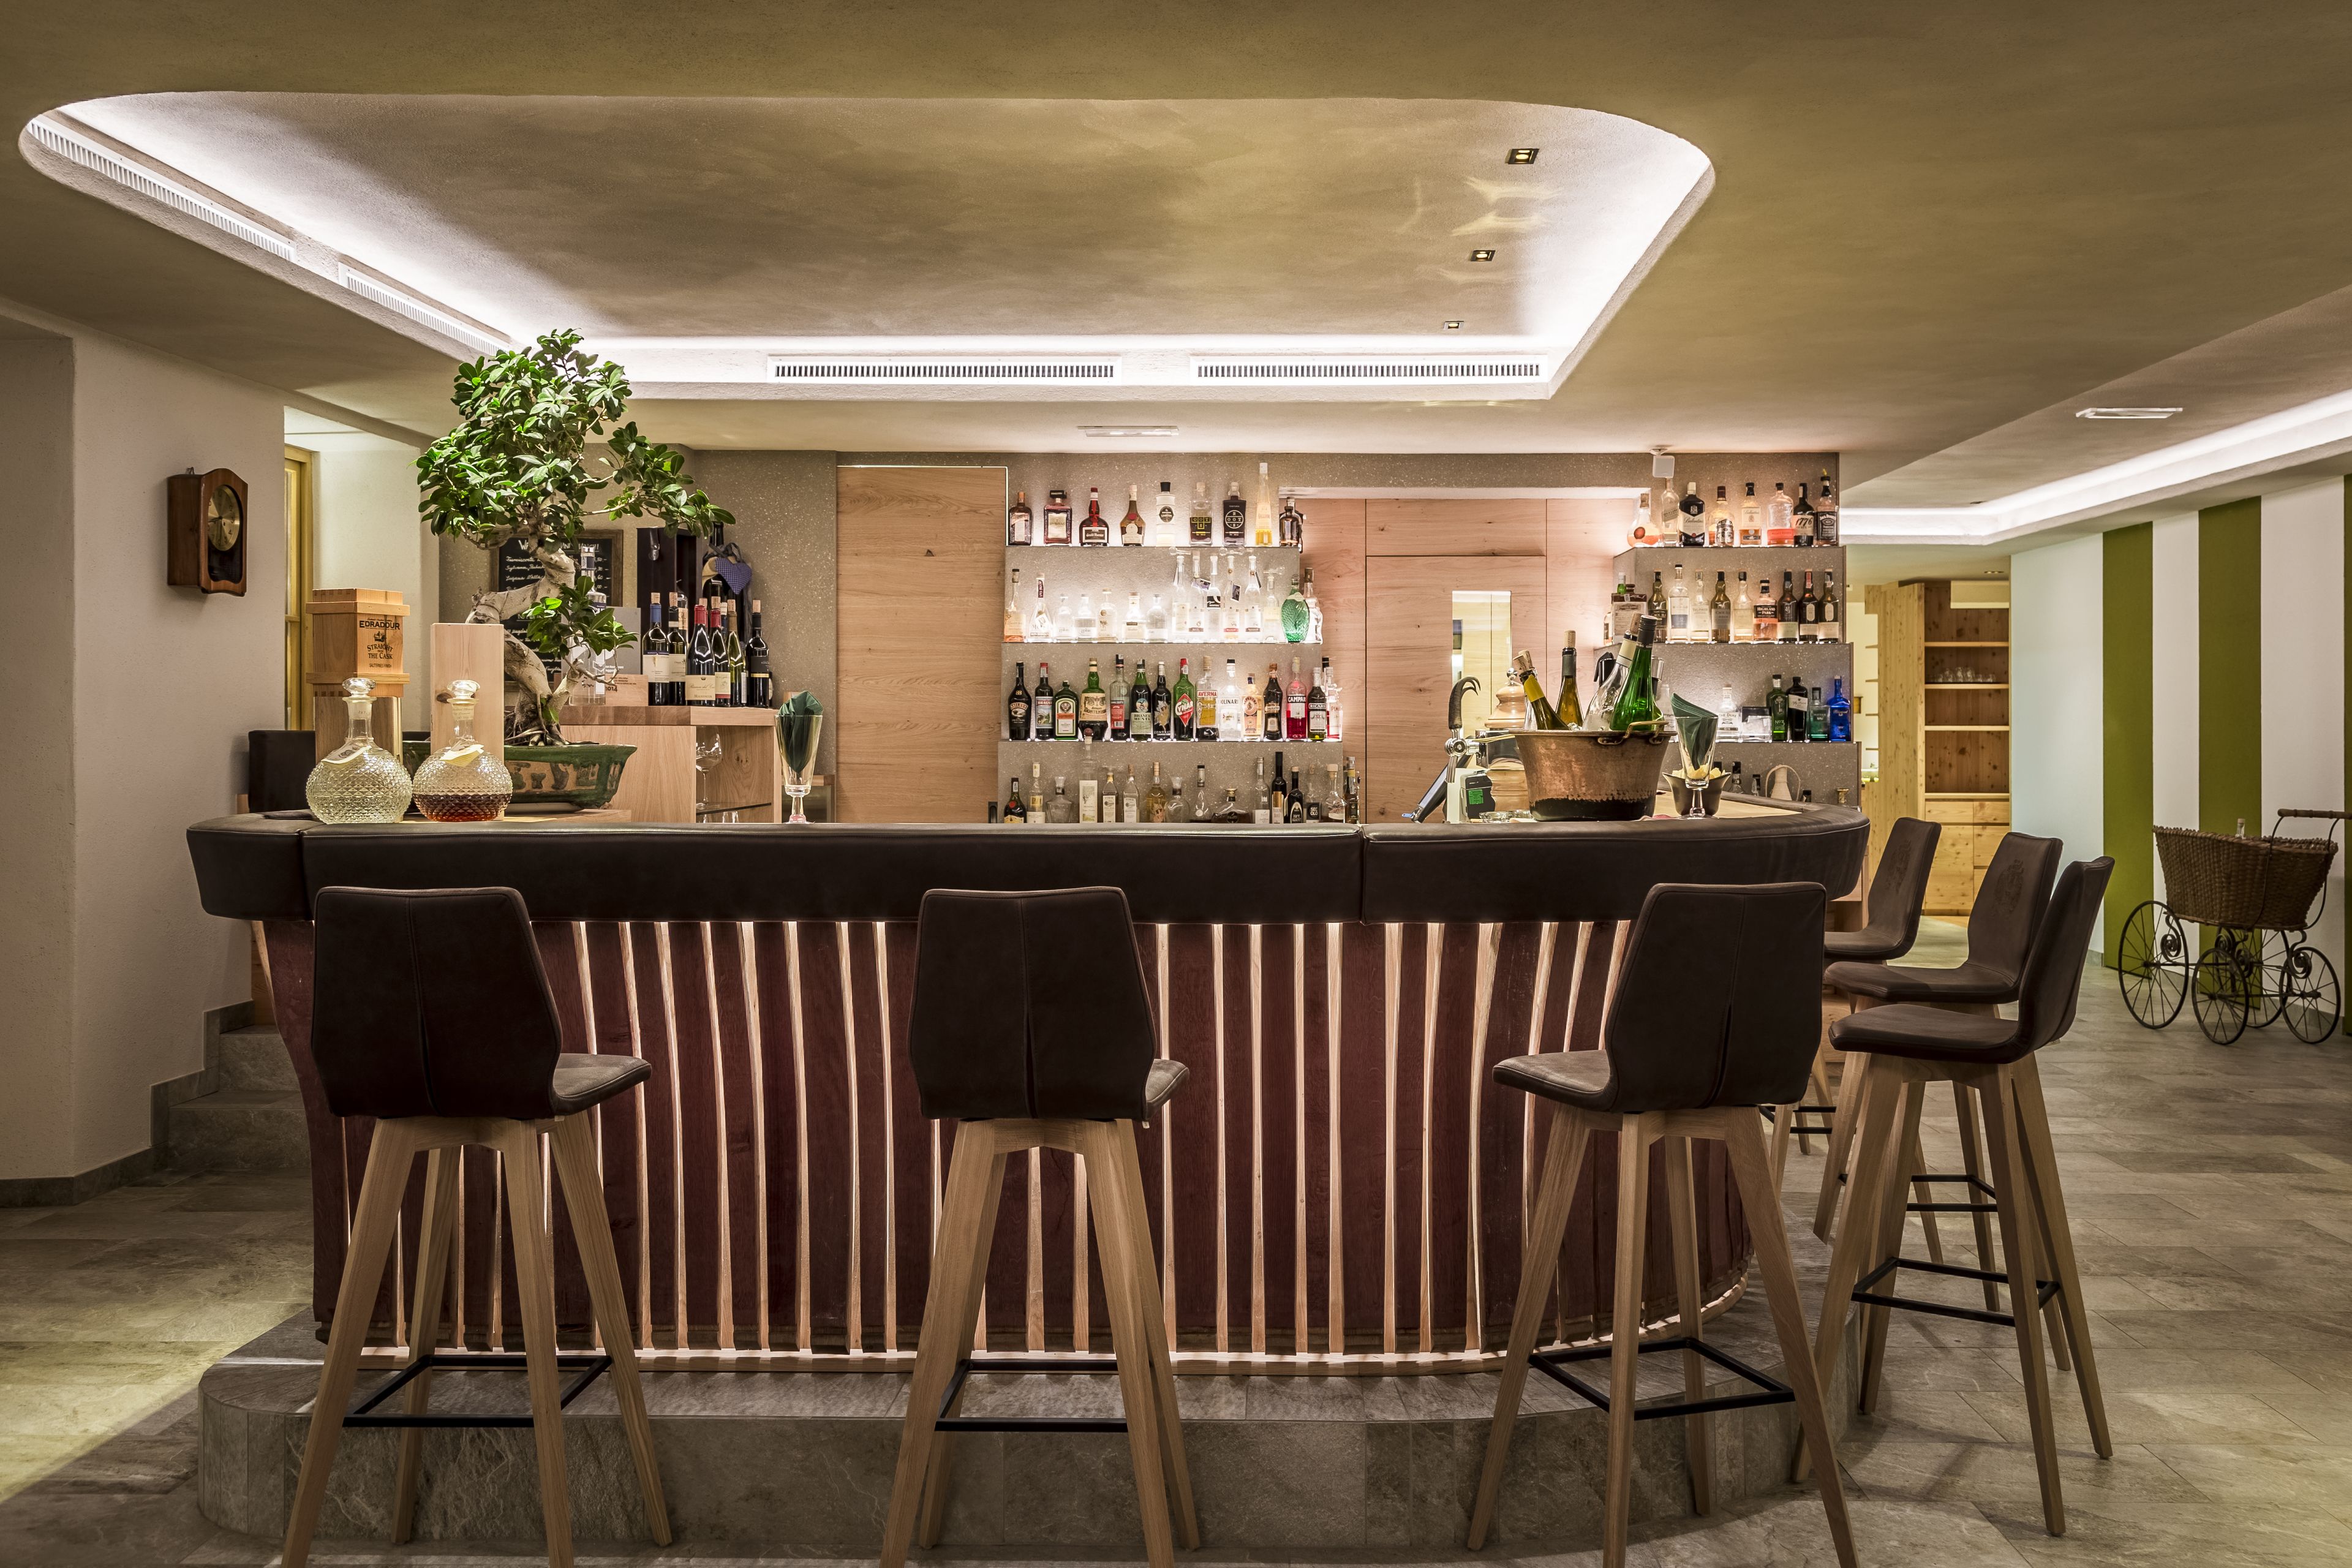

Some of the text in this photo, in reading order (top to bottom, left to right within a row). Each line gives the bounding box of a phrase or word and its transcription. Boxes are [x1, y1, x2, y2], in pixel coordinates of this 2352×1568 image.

[1795, 517, 1812, 526] 1776
[360, 620, 400, 630] EDRADOUR
[1175, 701, 1194, 716] CYNAR
